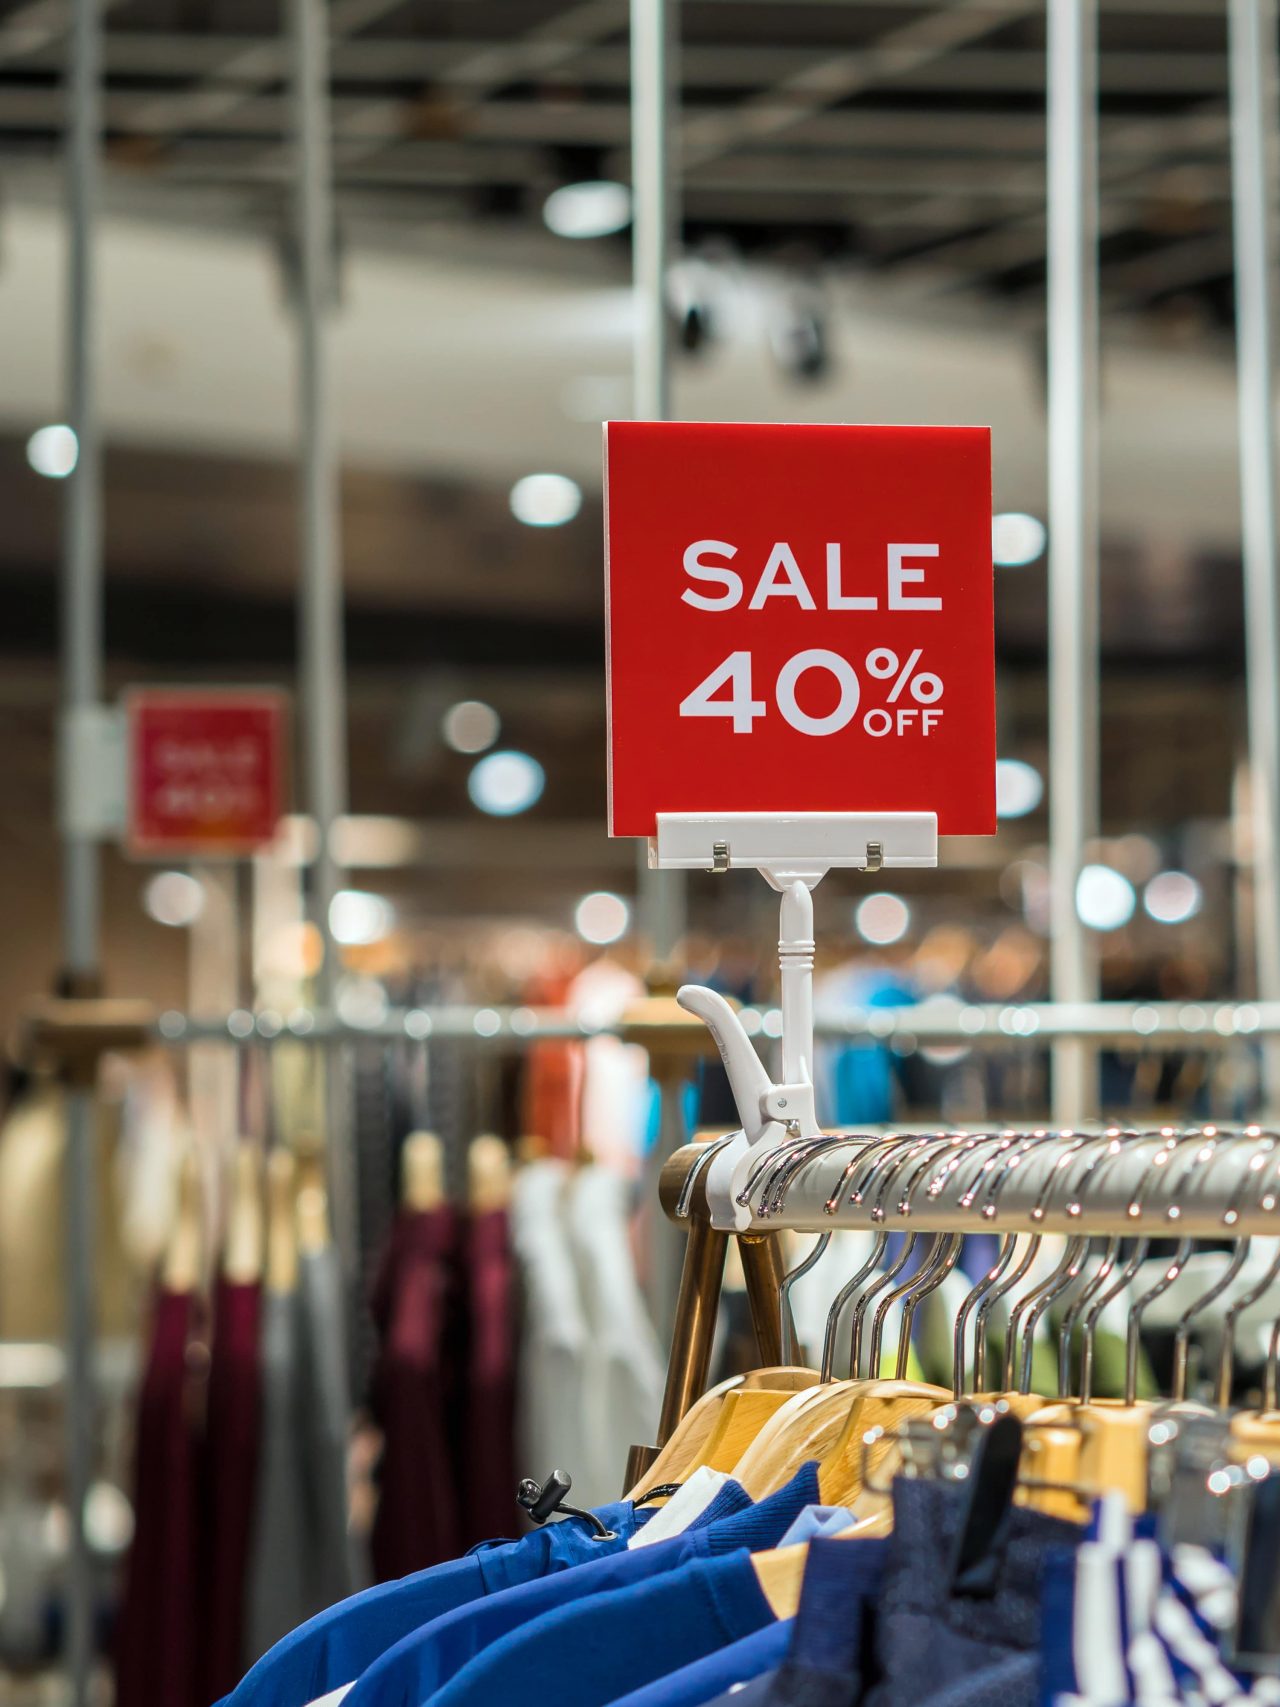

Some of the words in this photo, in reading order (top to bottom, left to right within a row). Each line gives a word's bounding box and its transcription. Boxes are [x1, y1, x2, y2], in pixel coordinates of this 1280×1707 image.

[680, 539, 943, 612] SALE
[679, 647, 944, 737] 40%
[863, 708, 944, 737] OFF
